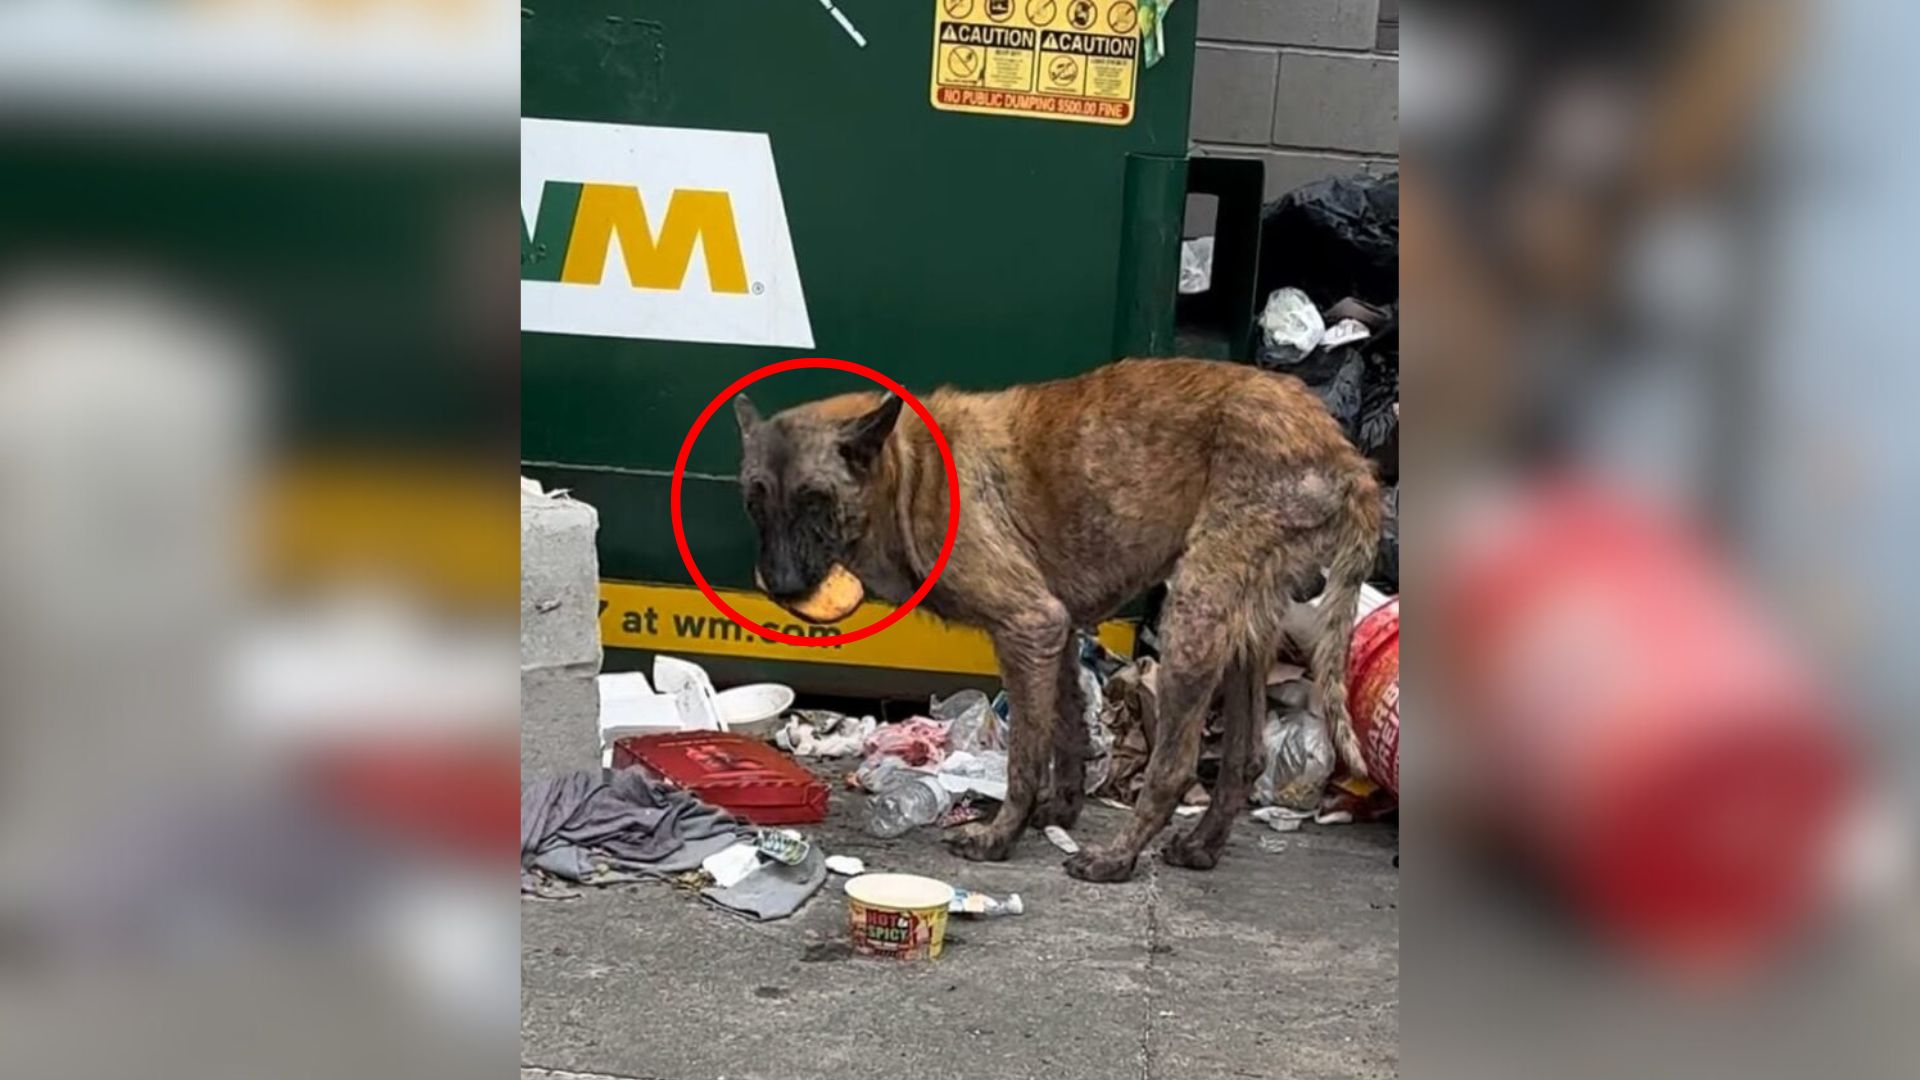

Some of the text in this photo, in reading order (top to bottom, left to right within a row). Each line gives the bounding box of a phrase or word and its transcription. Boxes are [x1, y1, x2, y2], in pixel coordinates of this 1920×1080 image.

[958, 24, 1035, 48] CAUTION
[1059, 33, 1135, 56] CAUTION
[943, 89, 1123, 118] NO PUBLIC DUMPING $500.00 FINE
[622, 607, 658, 635] at
[867, 925, 908, 941] SPICY
